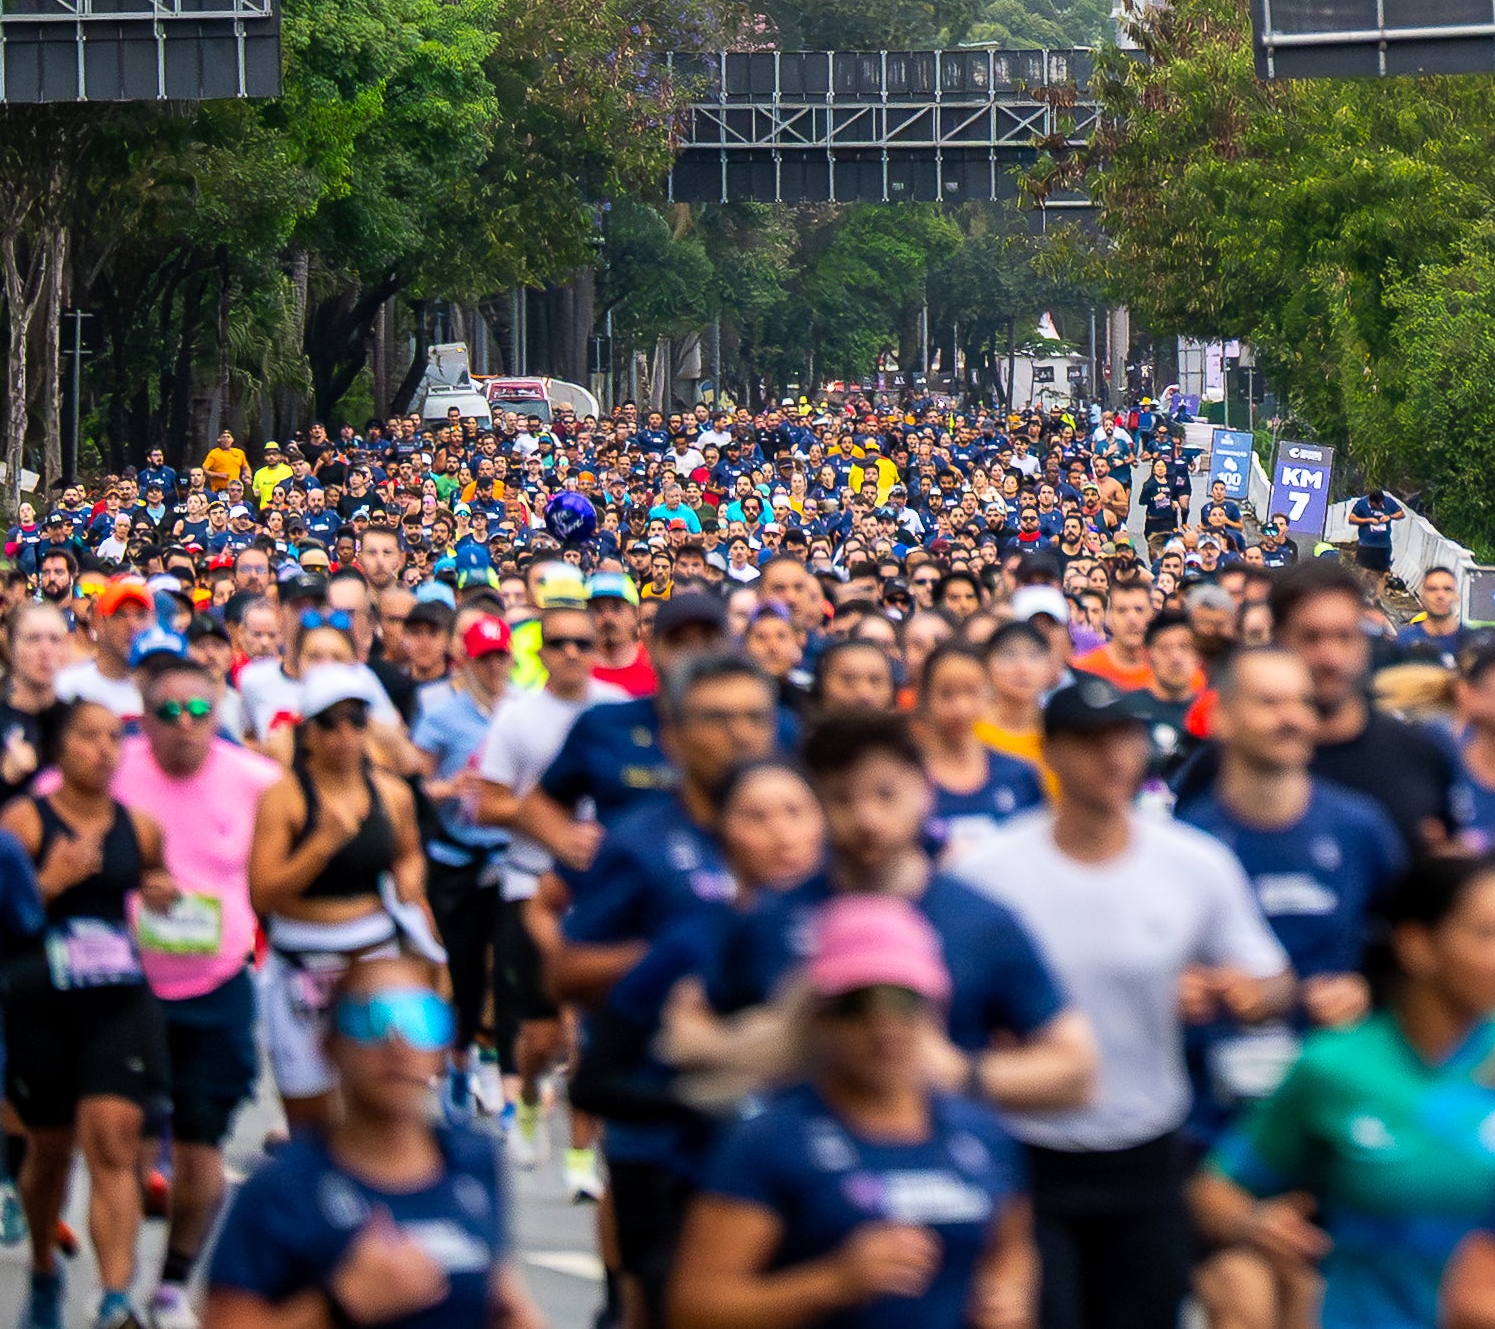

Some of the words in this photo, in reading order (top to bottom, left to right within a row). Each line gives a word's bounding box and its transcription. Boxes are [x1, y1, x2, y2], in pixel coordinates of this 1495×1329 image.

[1216, 471, 1242, 486] 100
[1282, 467, 1323, 489] KM
[1288, 491, 1310, 522] 7
